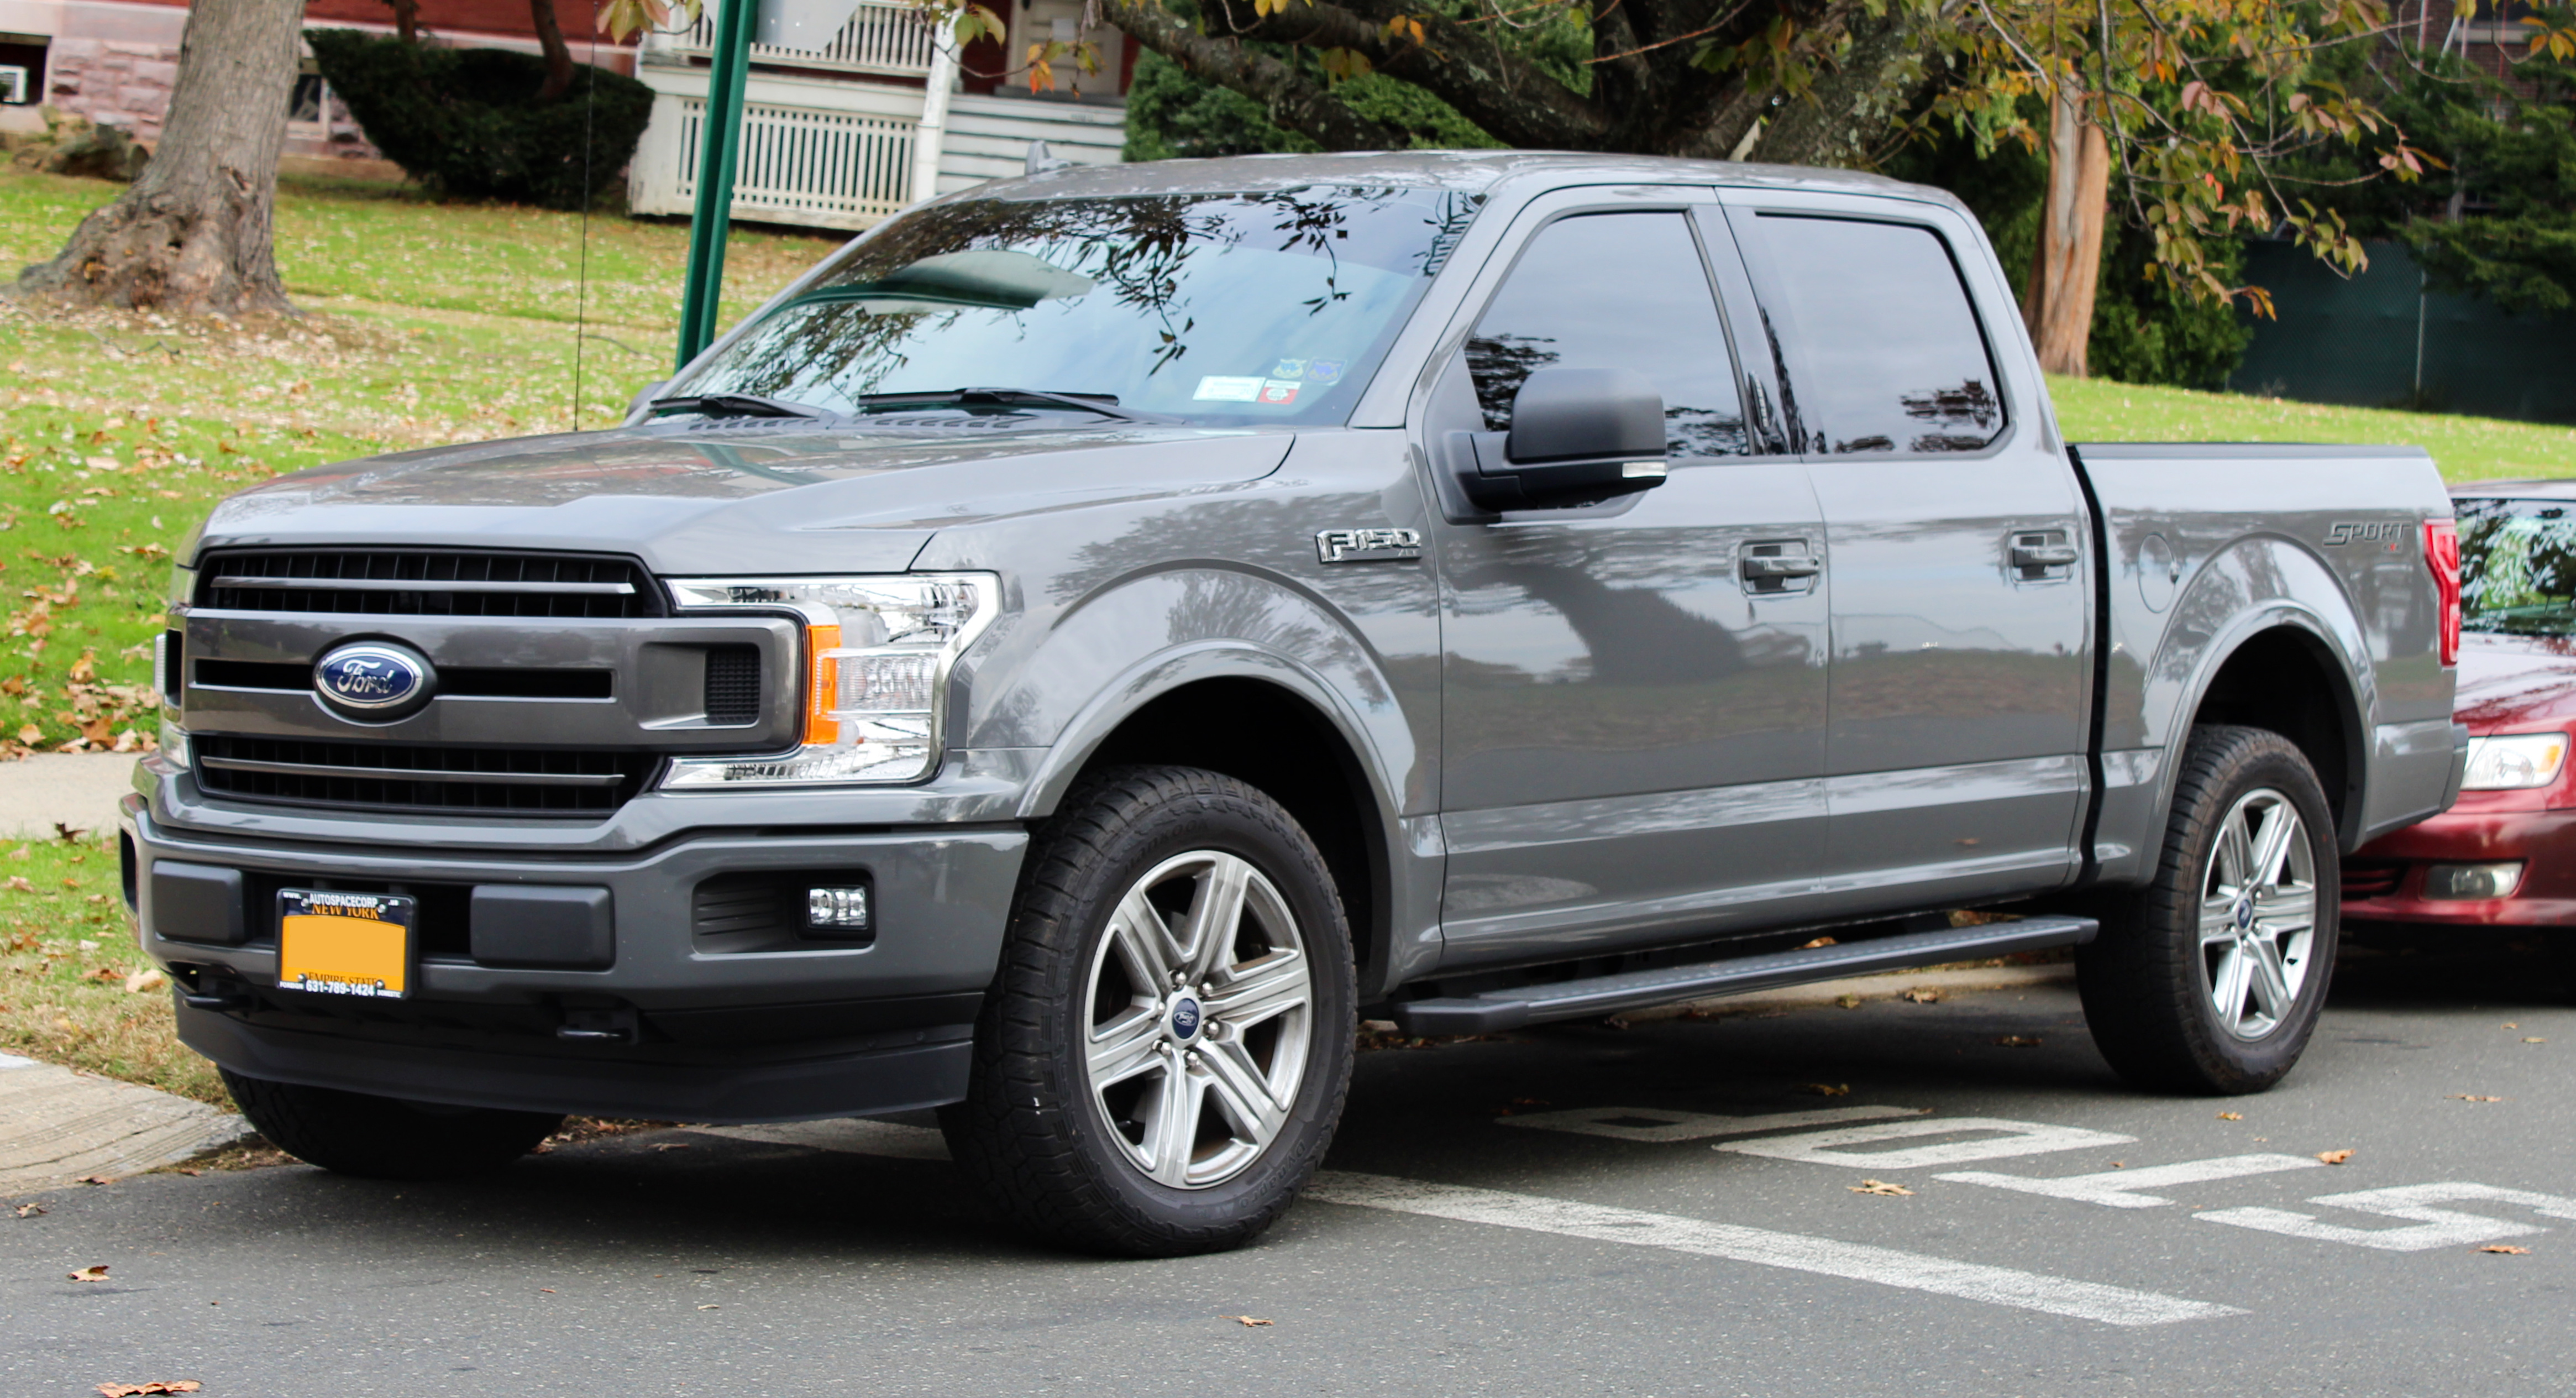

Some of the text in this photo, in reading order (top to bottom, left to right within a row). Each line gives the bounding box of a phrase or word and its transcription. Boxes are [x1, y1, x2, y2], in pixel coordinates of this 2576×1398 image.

[2323, 521, 2412, 547] SPORT
[336, 659, 395, 694] Ford
[309, 893, 378, 908] AUTOSPACECORP
[312, 904, 379, 920] NEW YORK
[306, 980, 375, 996] 631-789-1424
[1494, 1105, 2576, 1252] STOP
